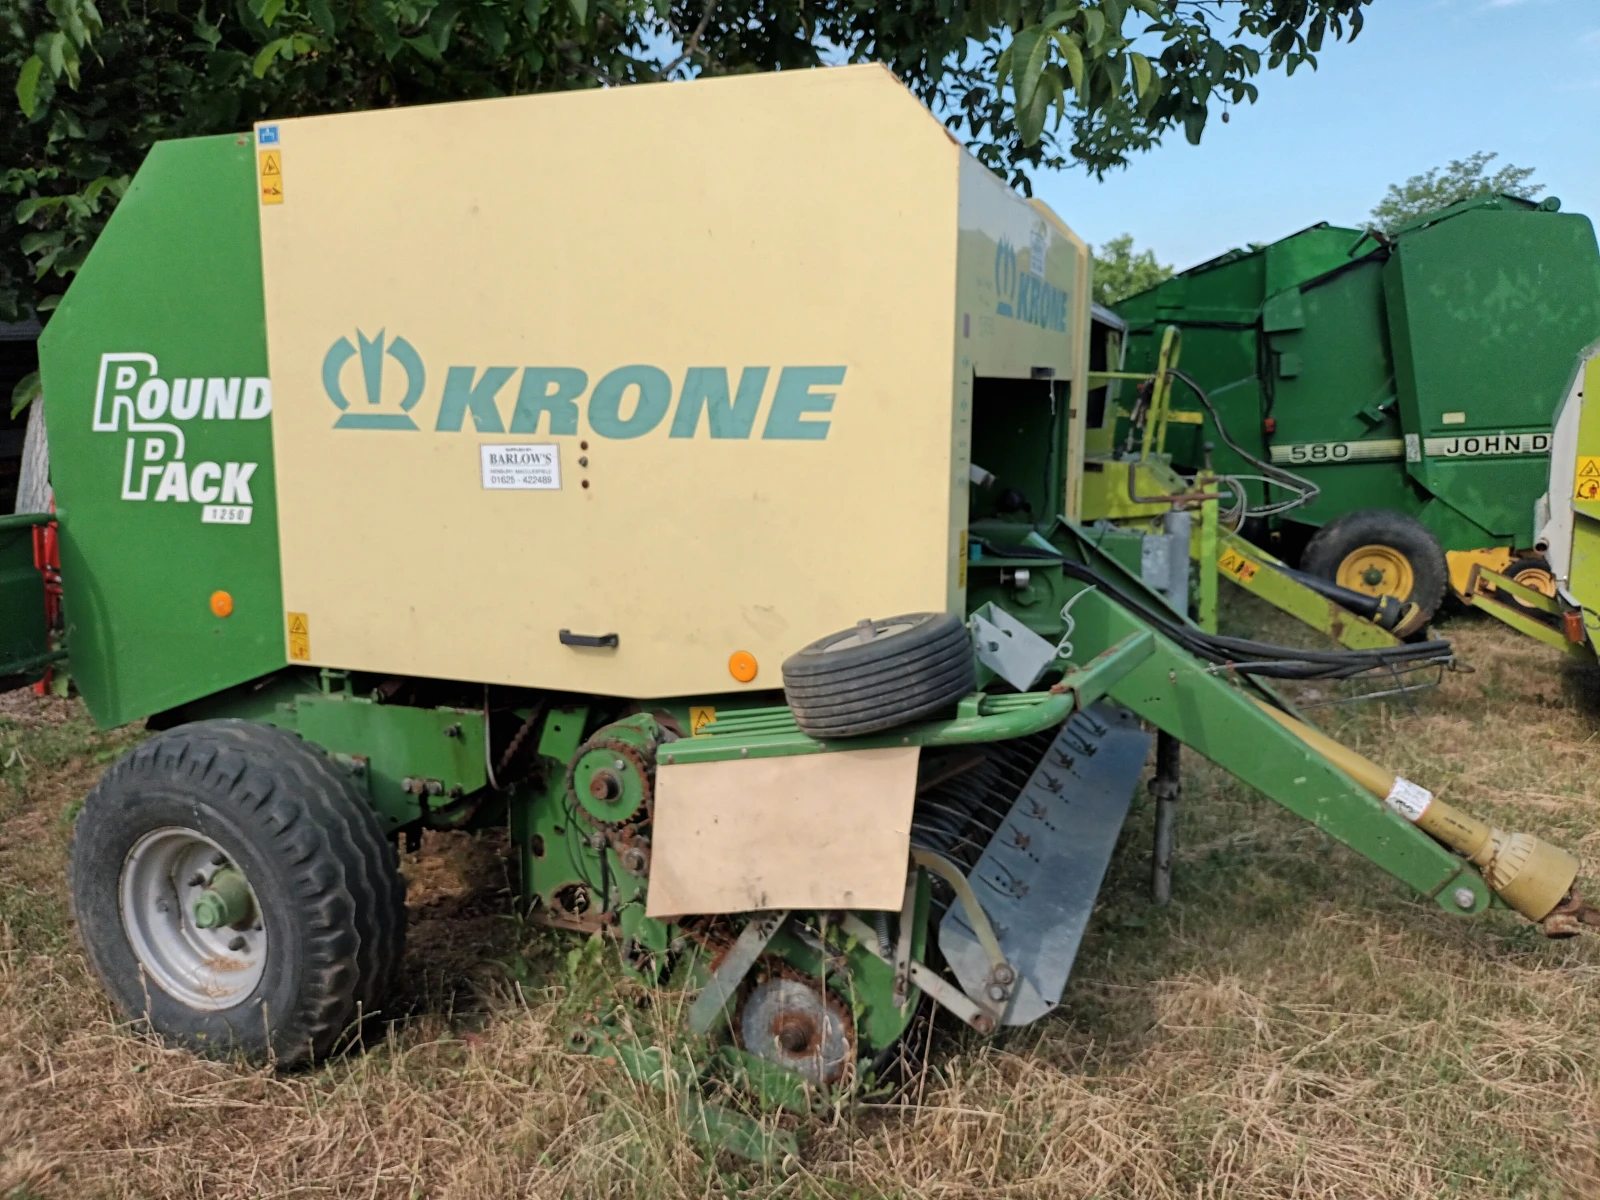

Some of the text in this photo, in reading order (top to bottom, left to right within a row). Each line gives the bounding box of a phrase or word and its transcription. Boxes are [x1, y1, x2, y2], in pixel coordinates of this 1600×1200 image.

[1015, 271, 1069, 333] KRONE
[92, 352, 272, 432] ROUND
[434, 364, 848, 440] KRONE
[1290, 443, 1349, 462] 580
[1446, 434, 1548, 455] JOHN D
[120, 423, 258, 504] PACK
[489, 453, 552, 465] BARLOW'S
[491, 475, 515, 484] 01625
[522, 475, 552, 484] 422489
[212, 508, 245, 521] 1250
